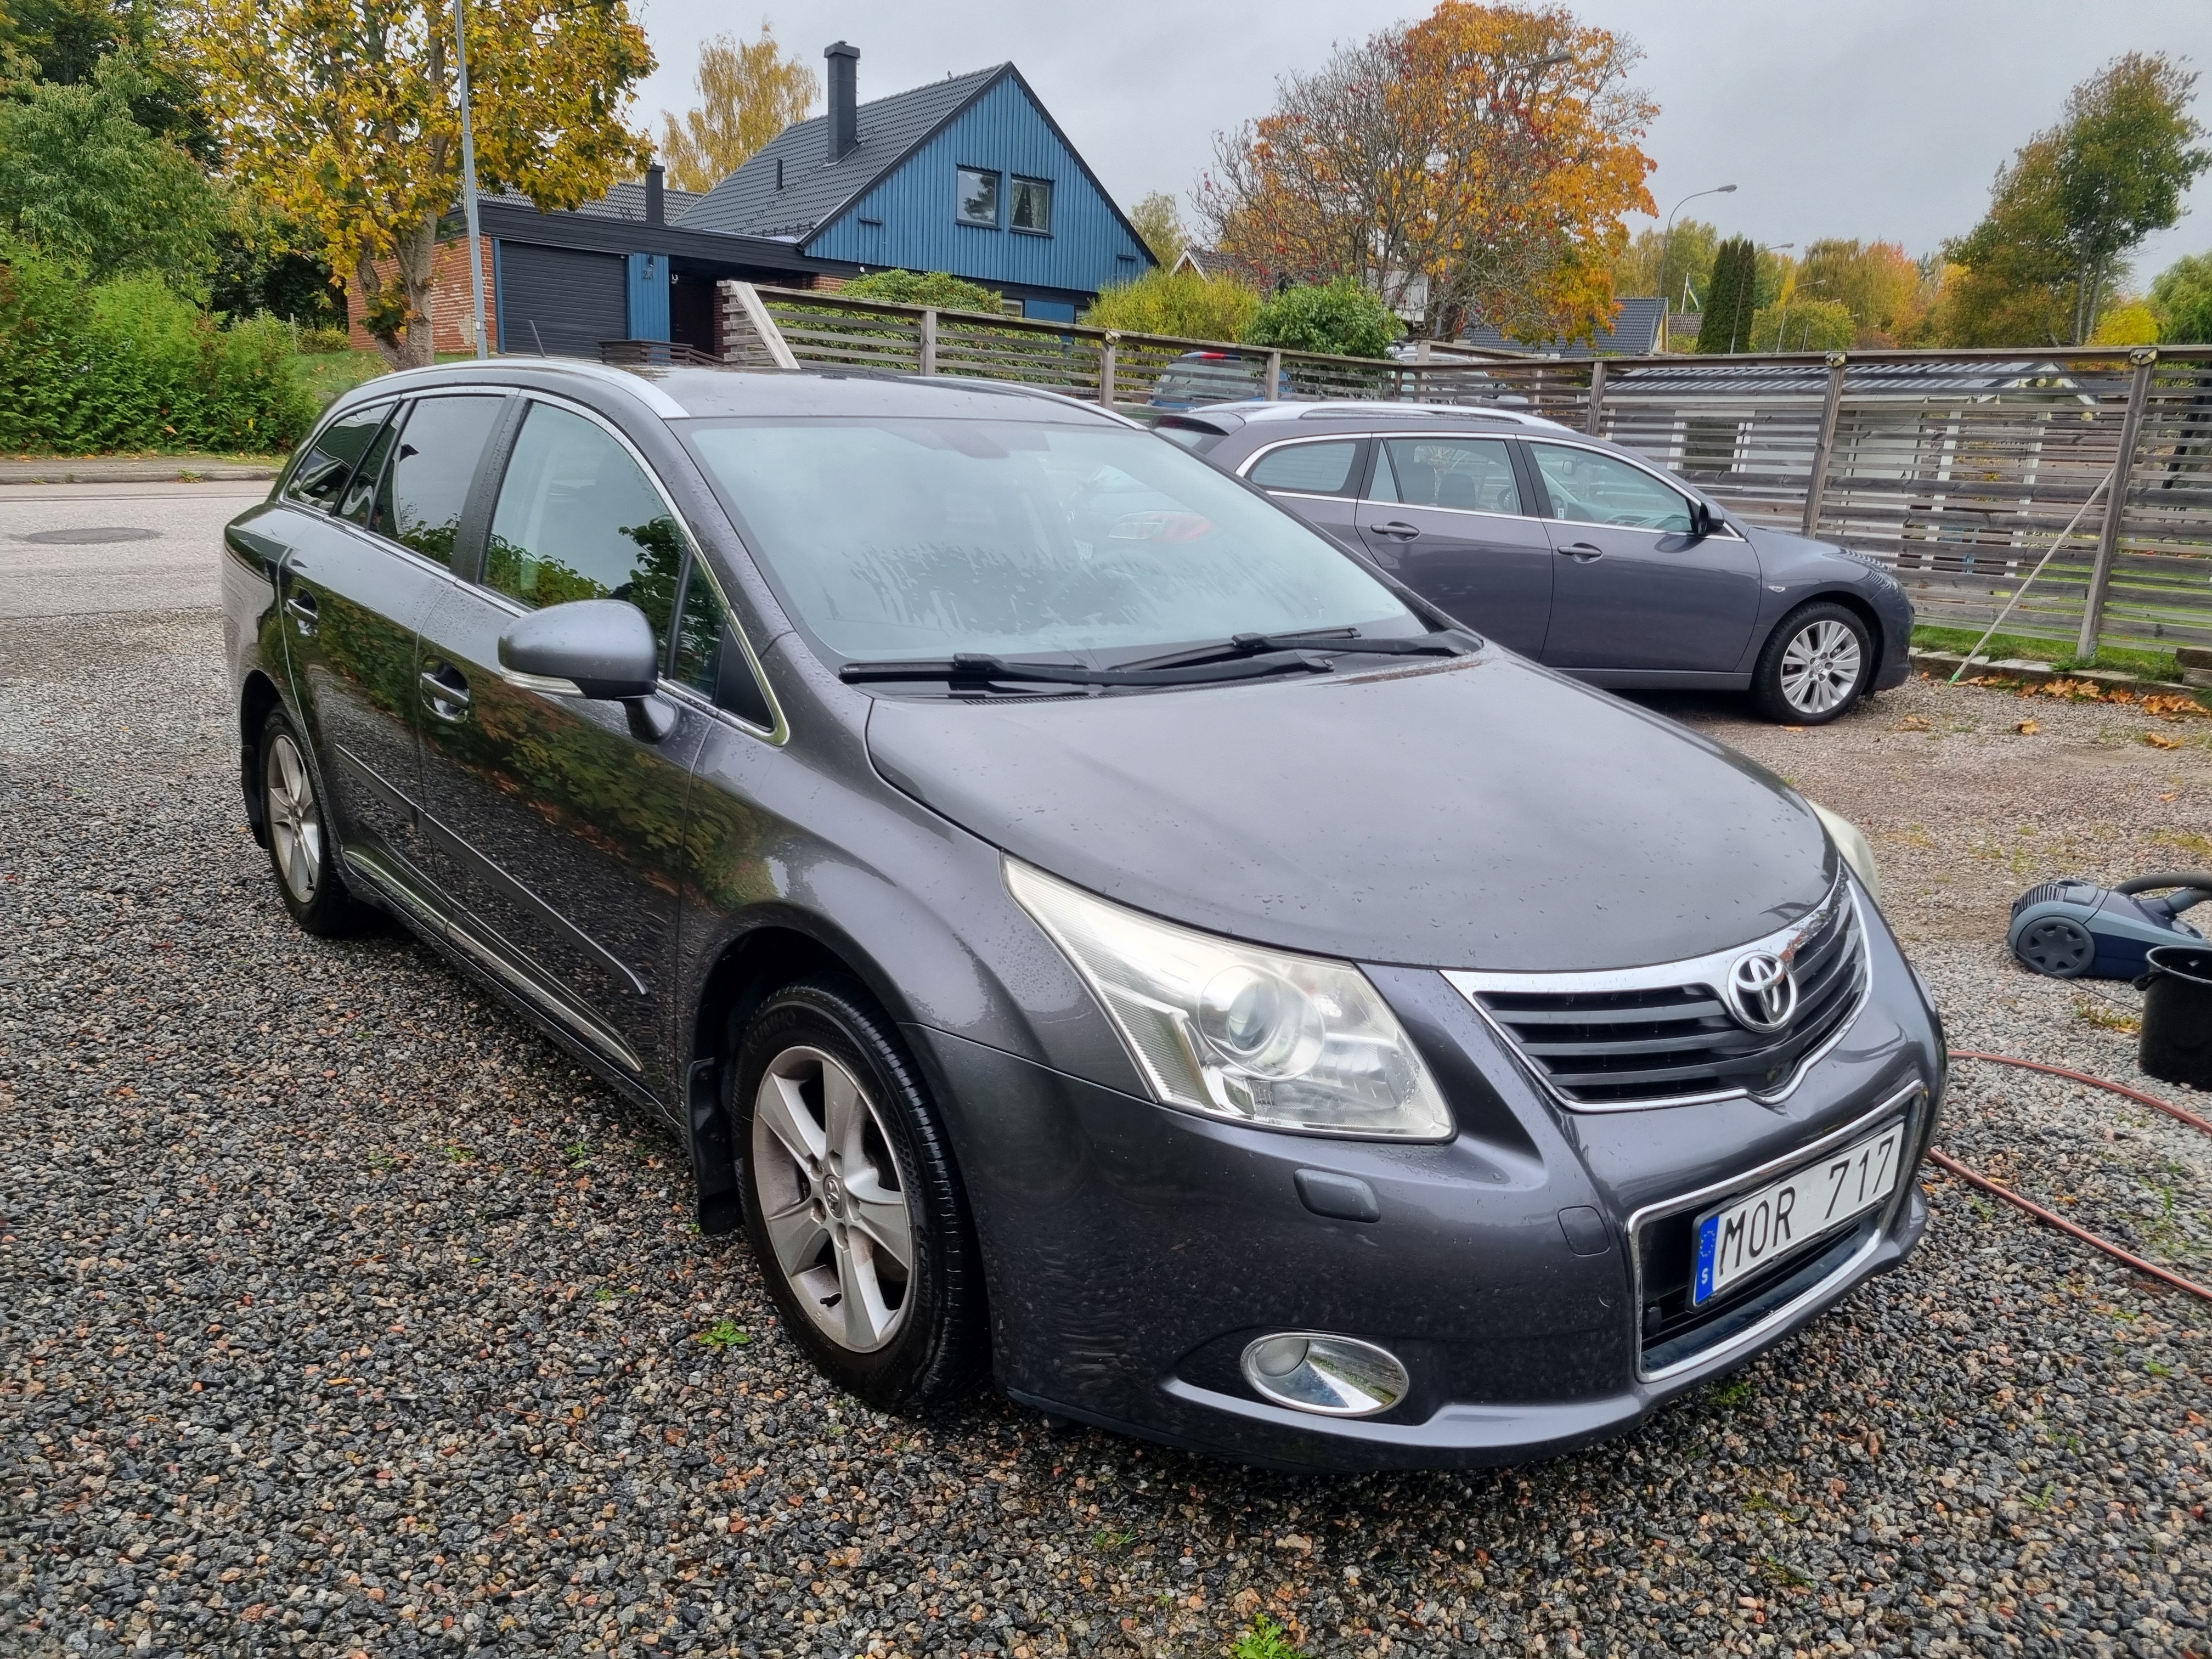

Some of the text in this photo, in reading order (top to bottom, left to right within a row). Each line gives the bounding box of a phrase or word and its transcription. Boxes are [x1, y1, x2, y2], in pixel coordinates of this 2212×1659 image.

[1719, 1134, 1895, 1277] MOR 717
[1701, 1267, 1708, 1284] S
